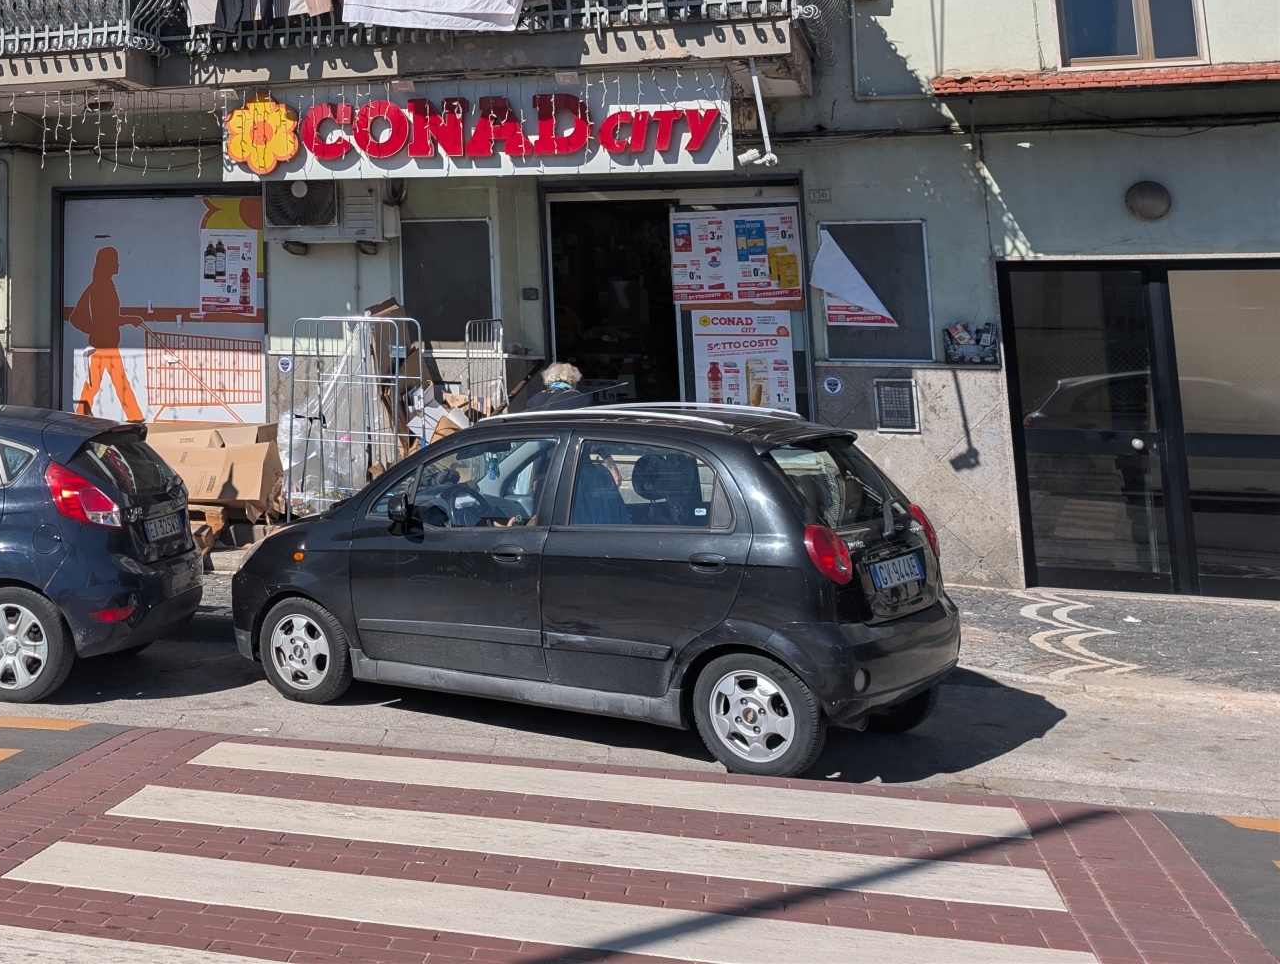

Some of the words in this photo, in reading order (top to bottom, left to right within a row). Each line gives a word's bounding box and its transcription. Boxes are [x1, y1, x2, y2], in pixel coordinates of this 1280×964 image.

[301, 92, 594, 159] CONAD
[598, 108, 720, 154] CITY
[711, 317, 753, 326] CONAD
